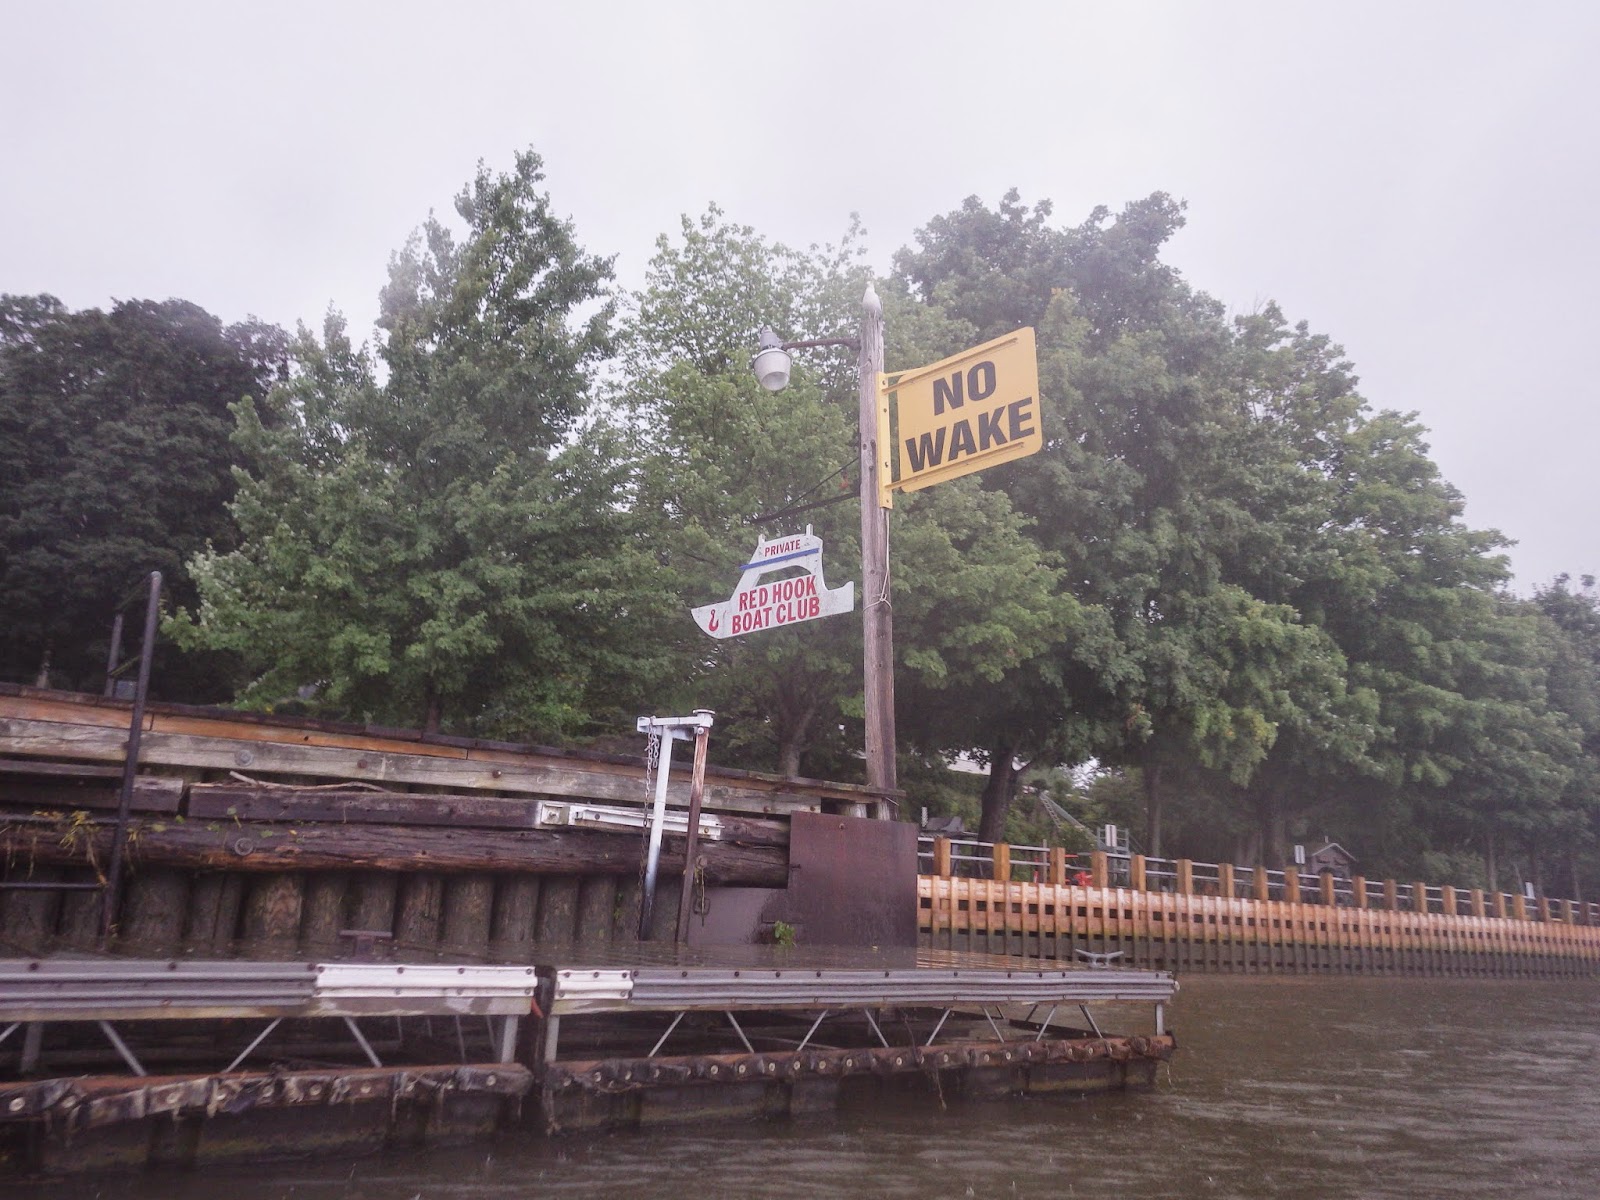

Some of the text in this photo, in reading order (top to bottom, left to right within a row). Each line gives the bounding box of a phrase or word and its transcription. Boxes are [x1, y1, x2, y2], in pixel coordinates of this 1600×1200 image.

[933, 361, 996, 416] NO
[905, 397, 1035, 473] WAKE
[764, 539, 801, 557] PRIVATE
[739, 575, 816, 612] RED HOOK
[732, 596, 820, 634] BOAT CLUB
